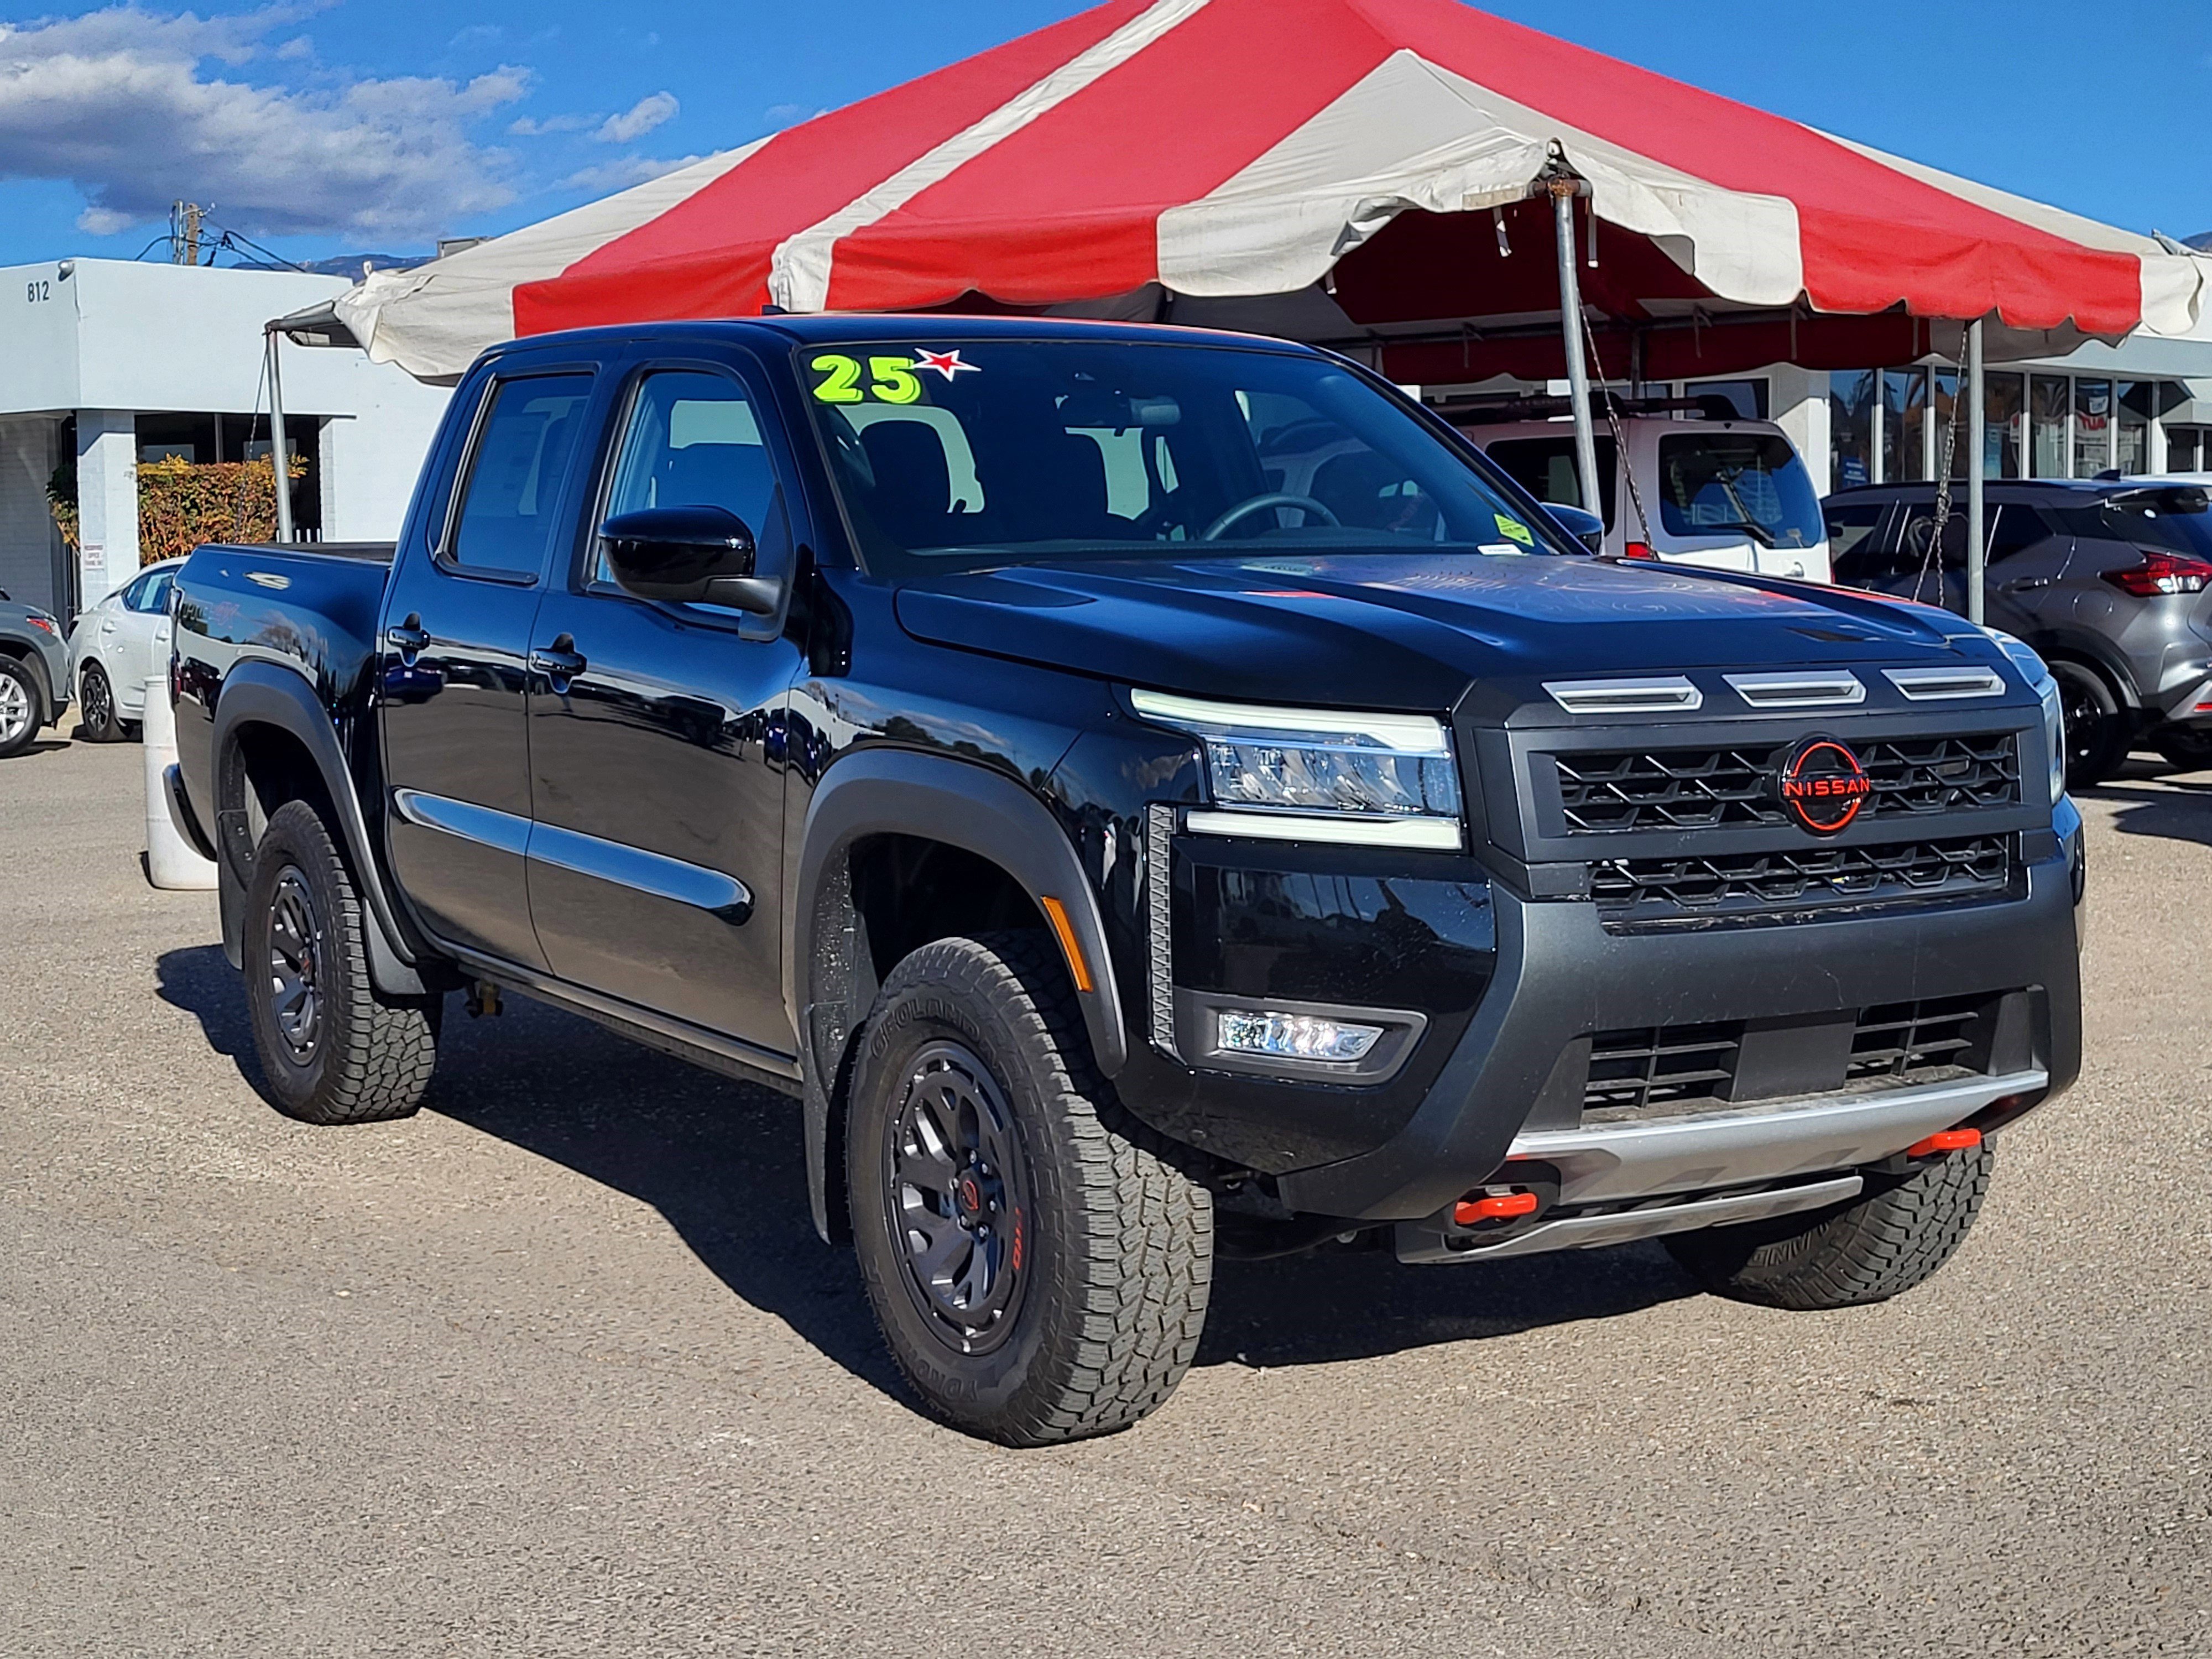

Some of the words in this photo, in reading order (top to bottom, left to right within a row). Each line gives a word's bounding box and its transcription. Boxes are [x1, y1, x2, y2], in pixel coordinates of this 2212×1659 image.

[28, 280, 49, 302] 812
[811, 354, 921, 404] 25
[1783, 778, 1870, 796] NISSAN
